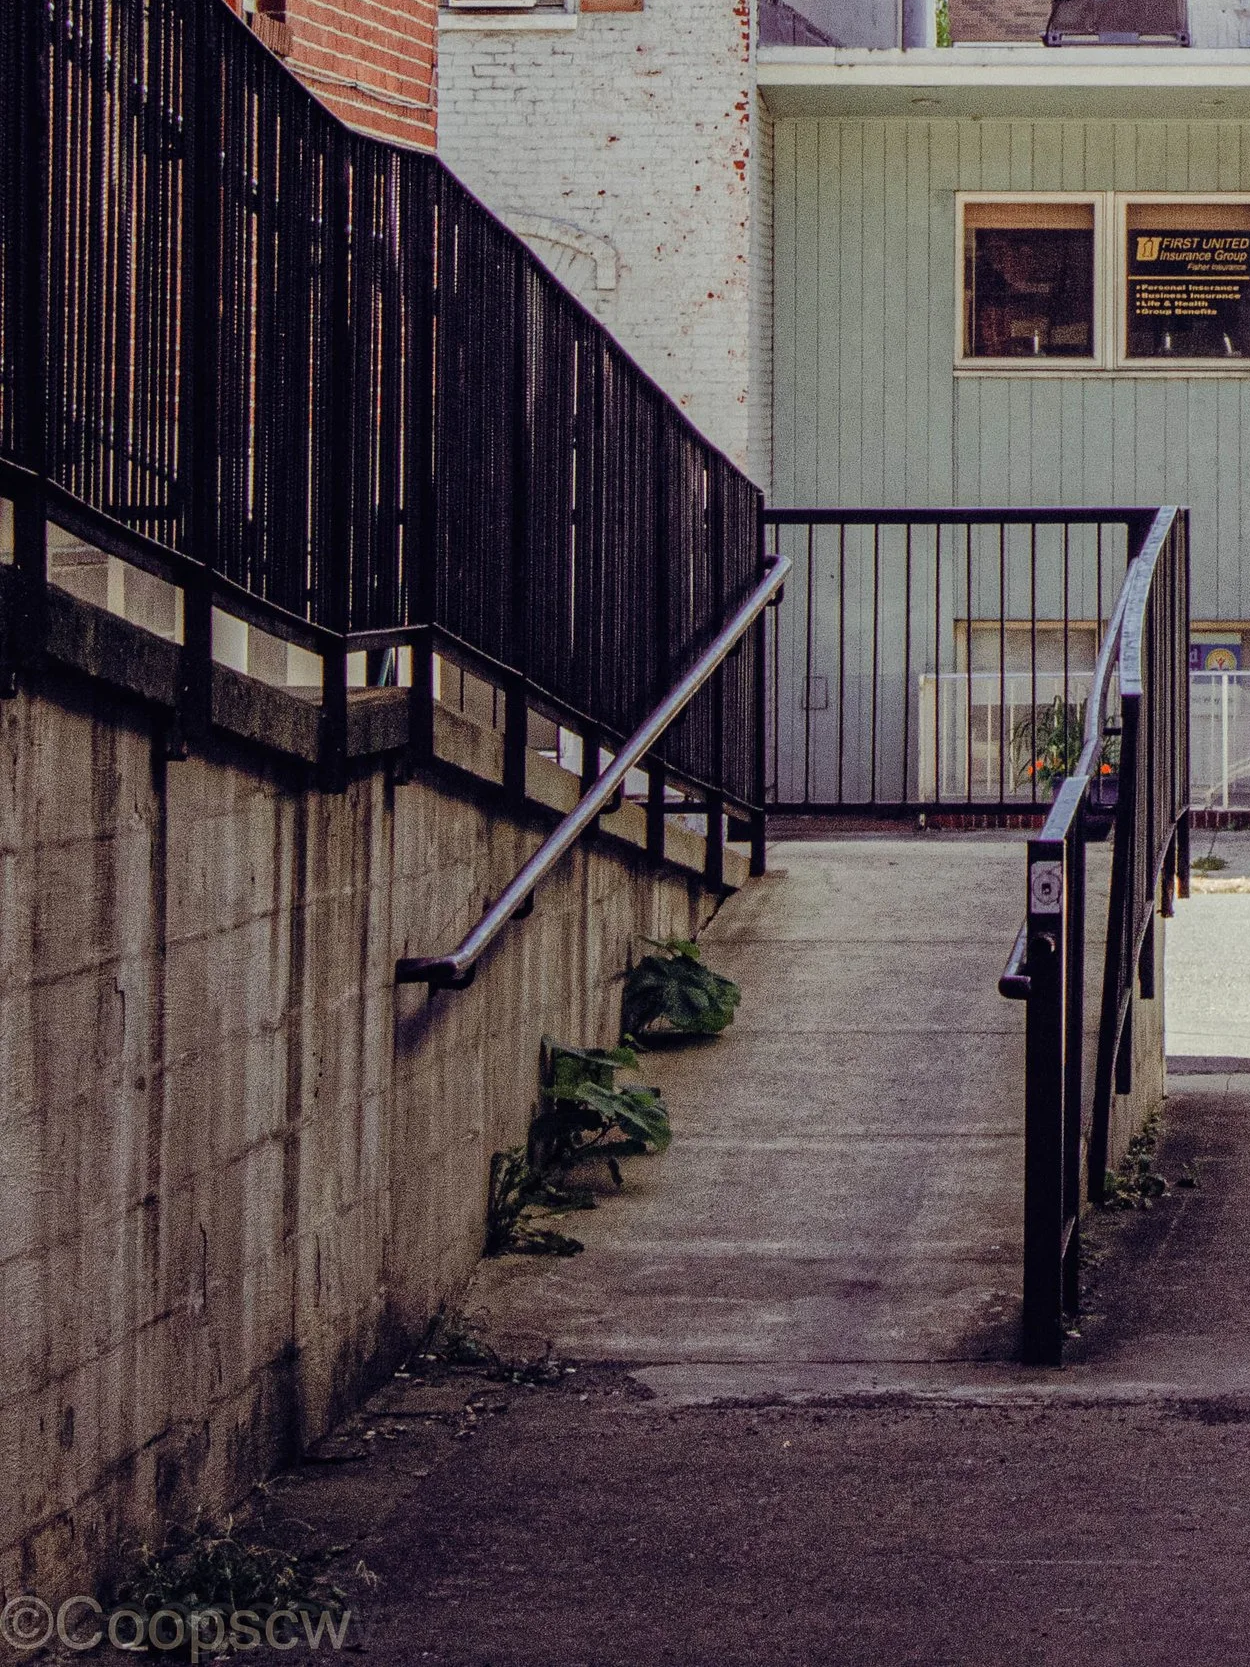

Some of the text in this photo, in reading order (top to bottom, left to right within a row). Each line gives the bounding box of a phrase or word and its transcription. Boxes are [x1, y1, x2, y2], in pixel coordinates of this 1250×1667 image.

[1161, 237, 1250, 249] FIRST UNITED
[1159, 249, 1248, 263] Insurance Group
[1190, 292, 1241, 300] Insurance
